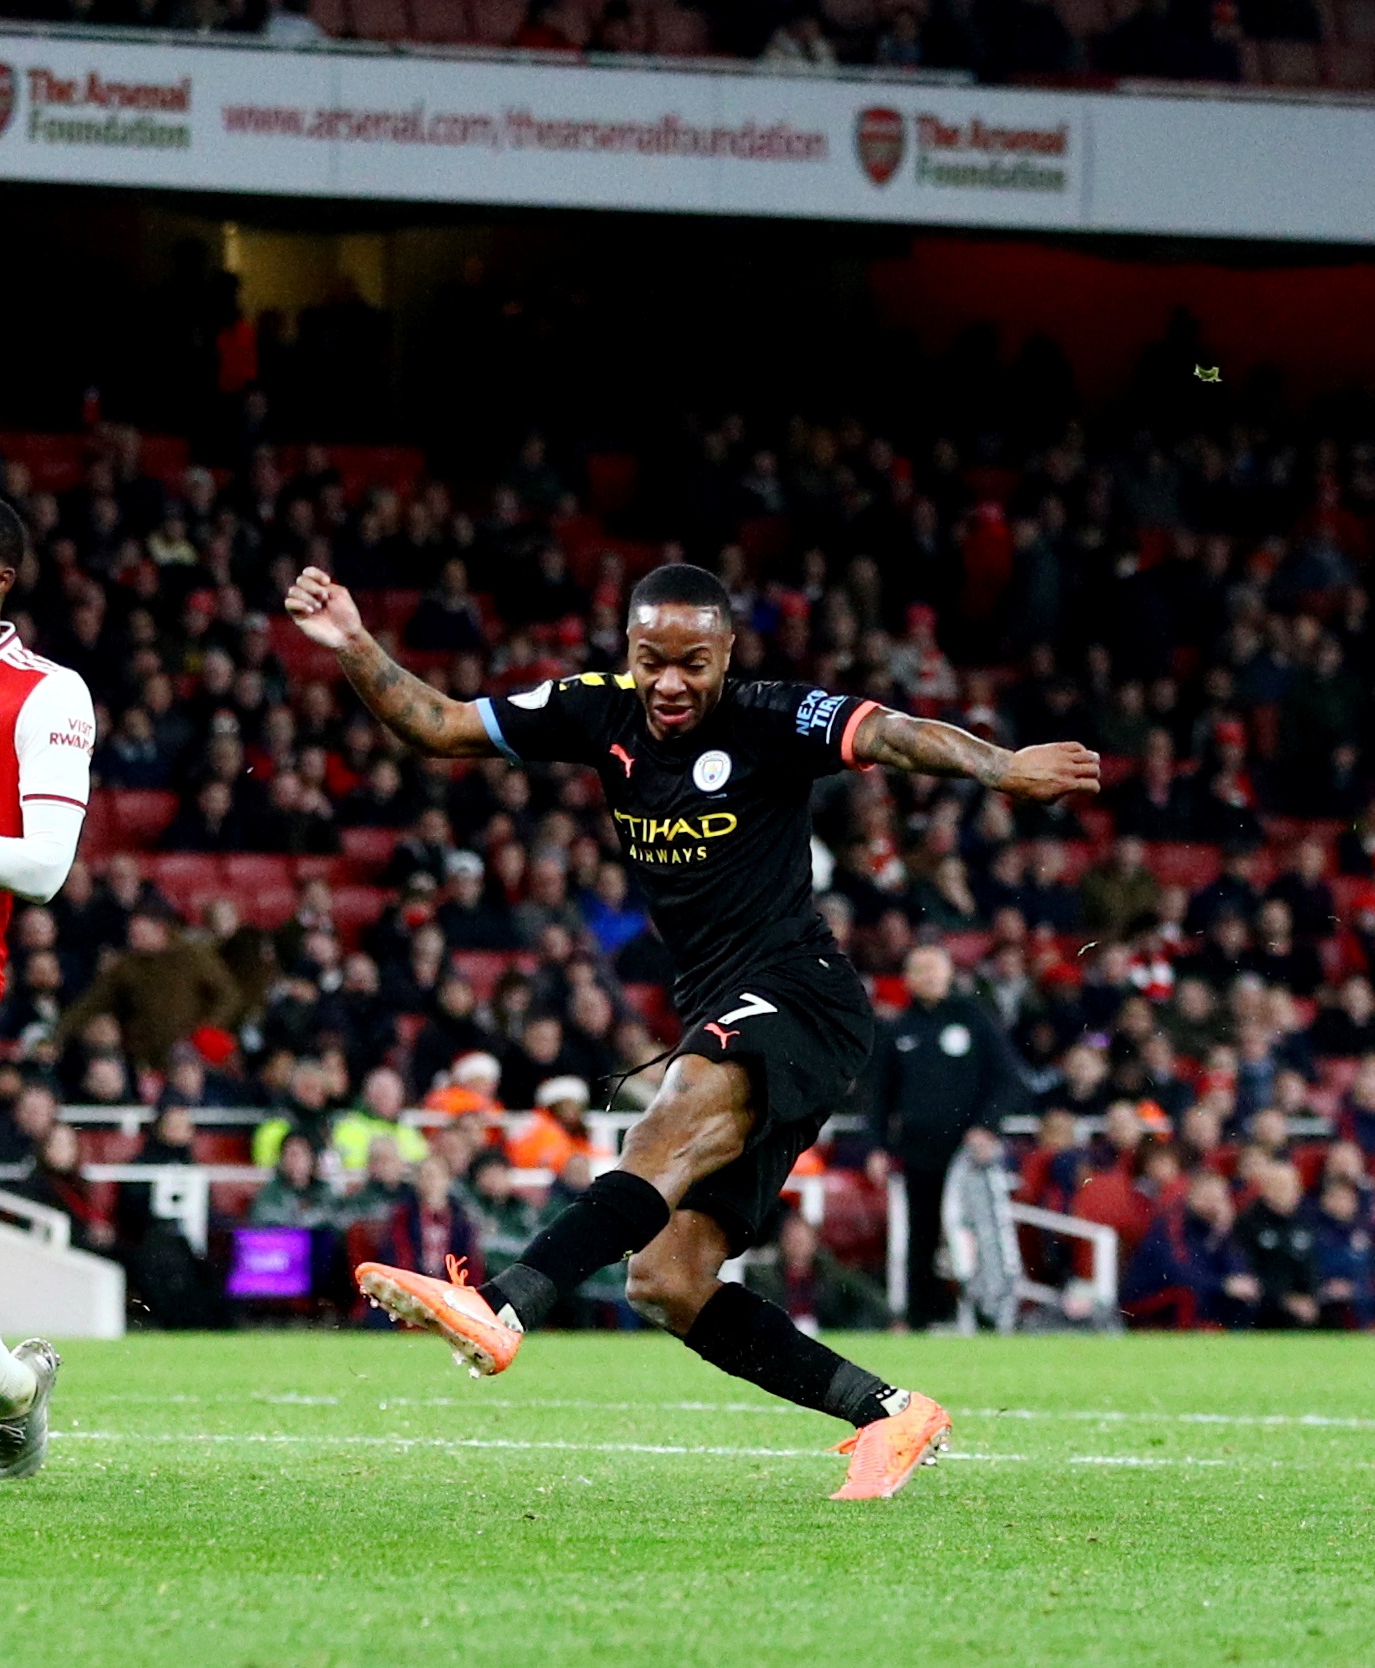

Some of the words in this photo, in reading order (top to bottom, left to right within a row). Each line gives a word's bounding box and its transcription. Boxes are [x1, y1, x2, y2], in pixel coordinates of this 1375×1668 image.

[28, 69, 73, 102] The
[84, 72, 192, 113] Arsenal
[28, 110, 192, 149] Foundation
[916, 113, 958, 146] The
[970, 116, 1068, 158] Arsenal
[916, 152, 1066, 191] Foundation
[630, 844, 707, 864] AIRWAYS
[718, 992, 778, 1025] 7
